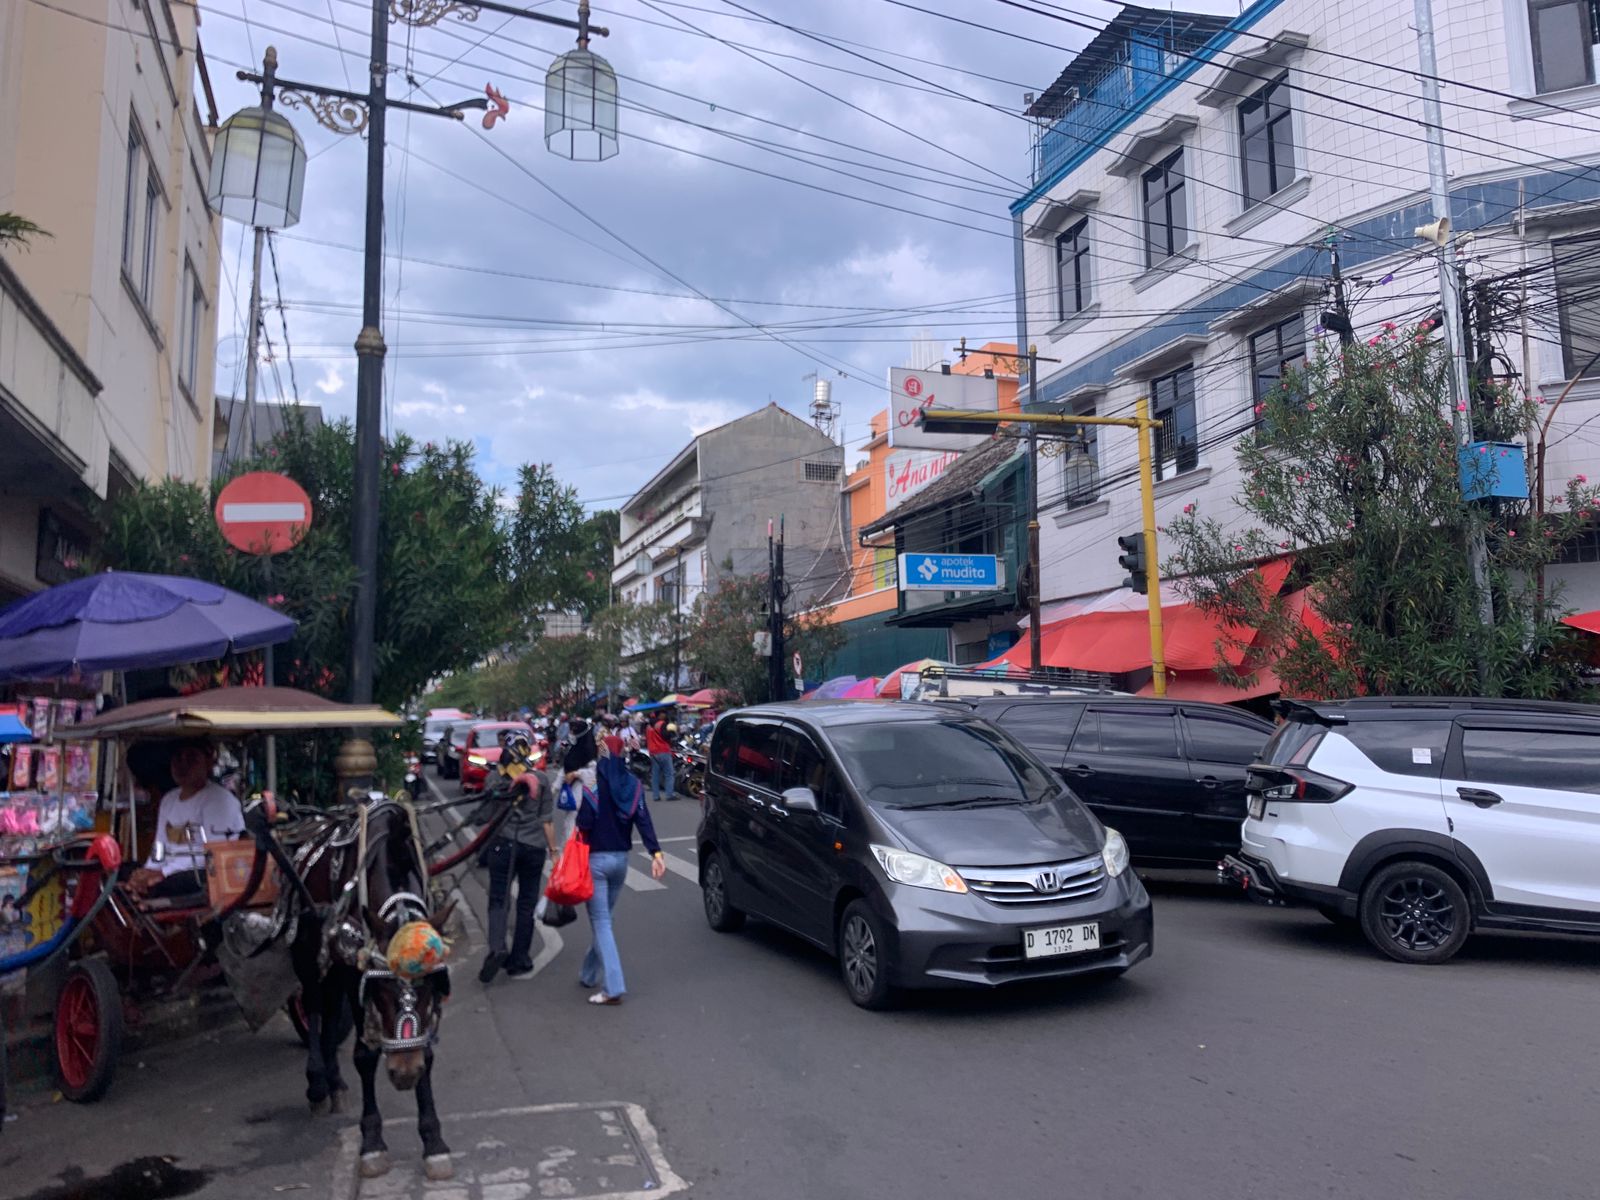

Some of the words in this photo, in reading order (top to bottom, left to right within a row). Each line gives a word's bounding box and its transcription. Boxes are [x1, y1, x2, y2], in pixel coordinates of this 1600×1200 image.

[941, 557, 974, 567] apotek
[941, 567, 986, 579] mudita
[1027, 933, 1035, 948] D
[1045, 928, 1074, 946] 1792
[1083, 925, 1097, 940] DK
